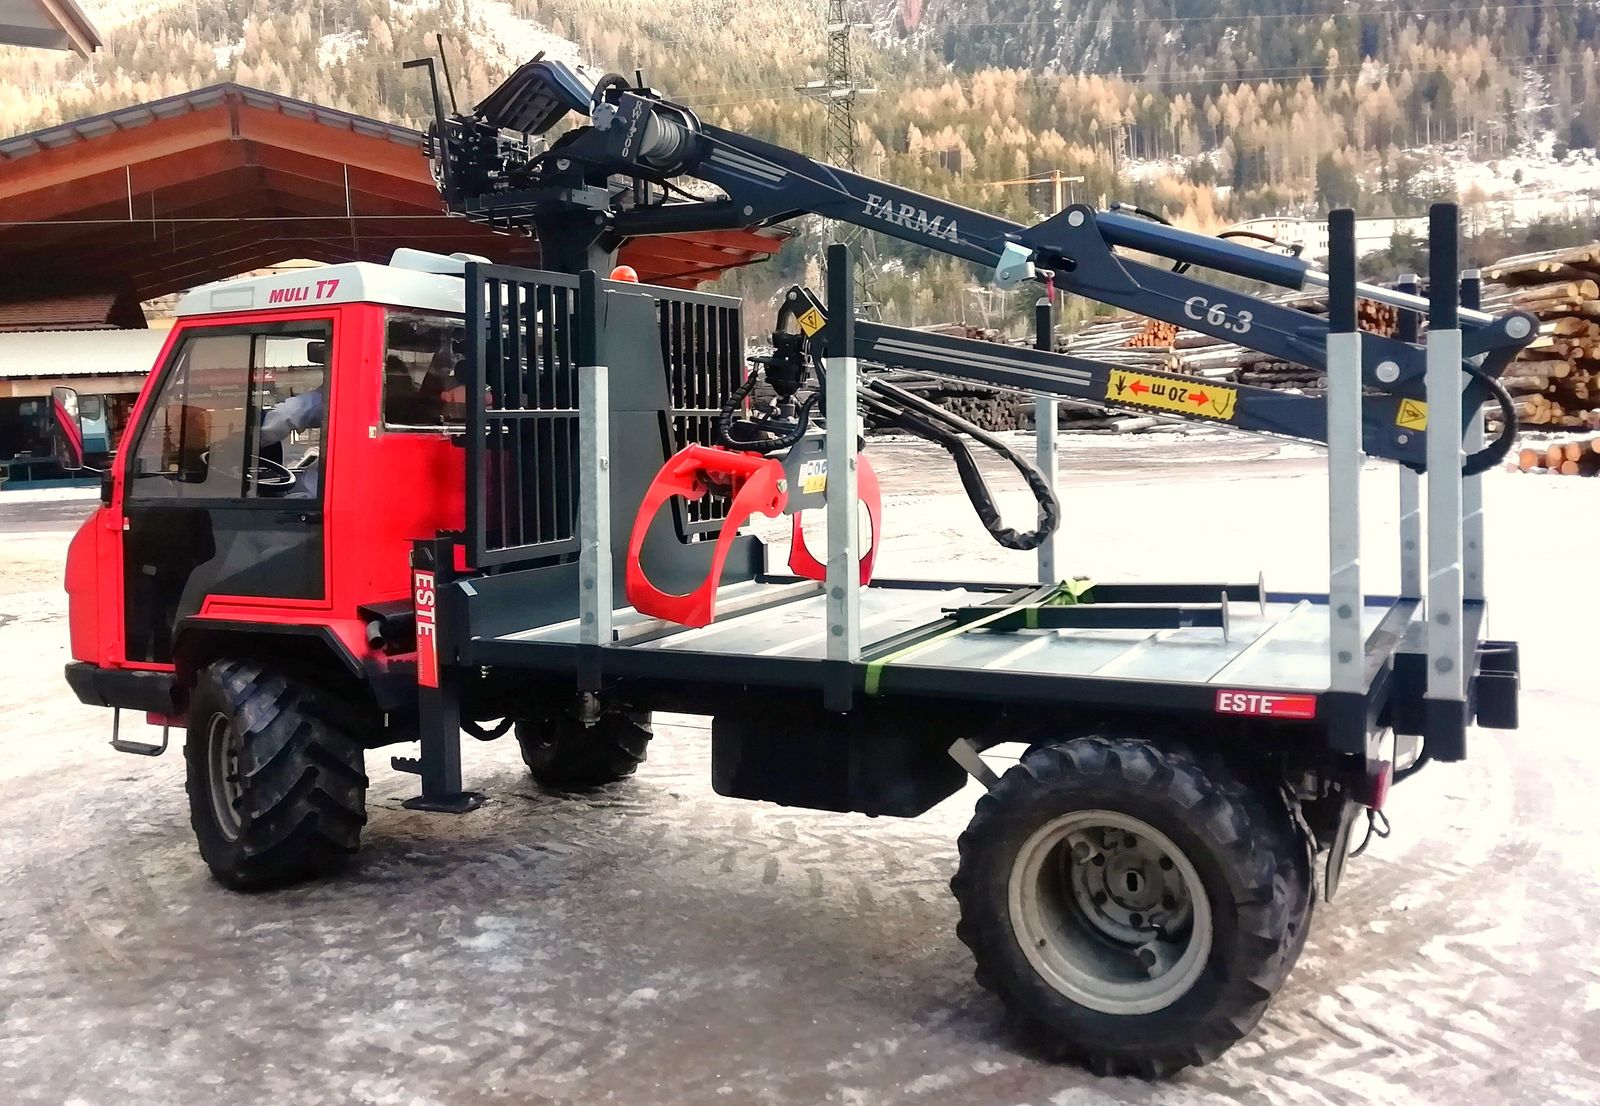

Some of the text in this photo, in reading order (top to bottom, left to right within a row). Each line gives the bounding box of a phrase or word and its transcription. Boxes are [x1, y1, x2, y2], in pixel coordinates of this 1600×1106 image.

[862, 193, 960, 245] FARMA
[268, 279, 341, 304] MULI T7
[1184, 295, 1254, 334] C6.3
[1151, 383, 1189, 403] 20 m
[415, 573, 437, 636] ESTE
[1219, 692, 1274, 714] ESTE
